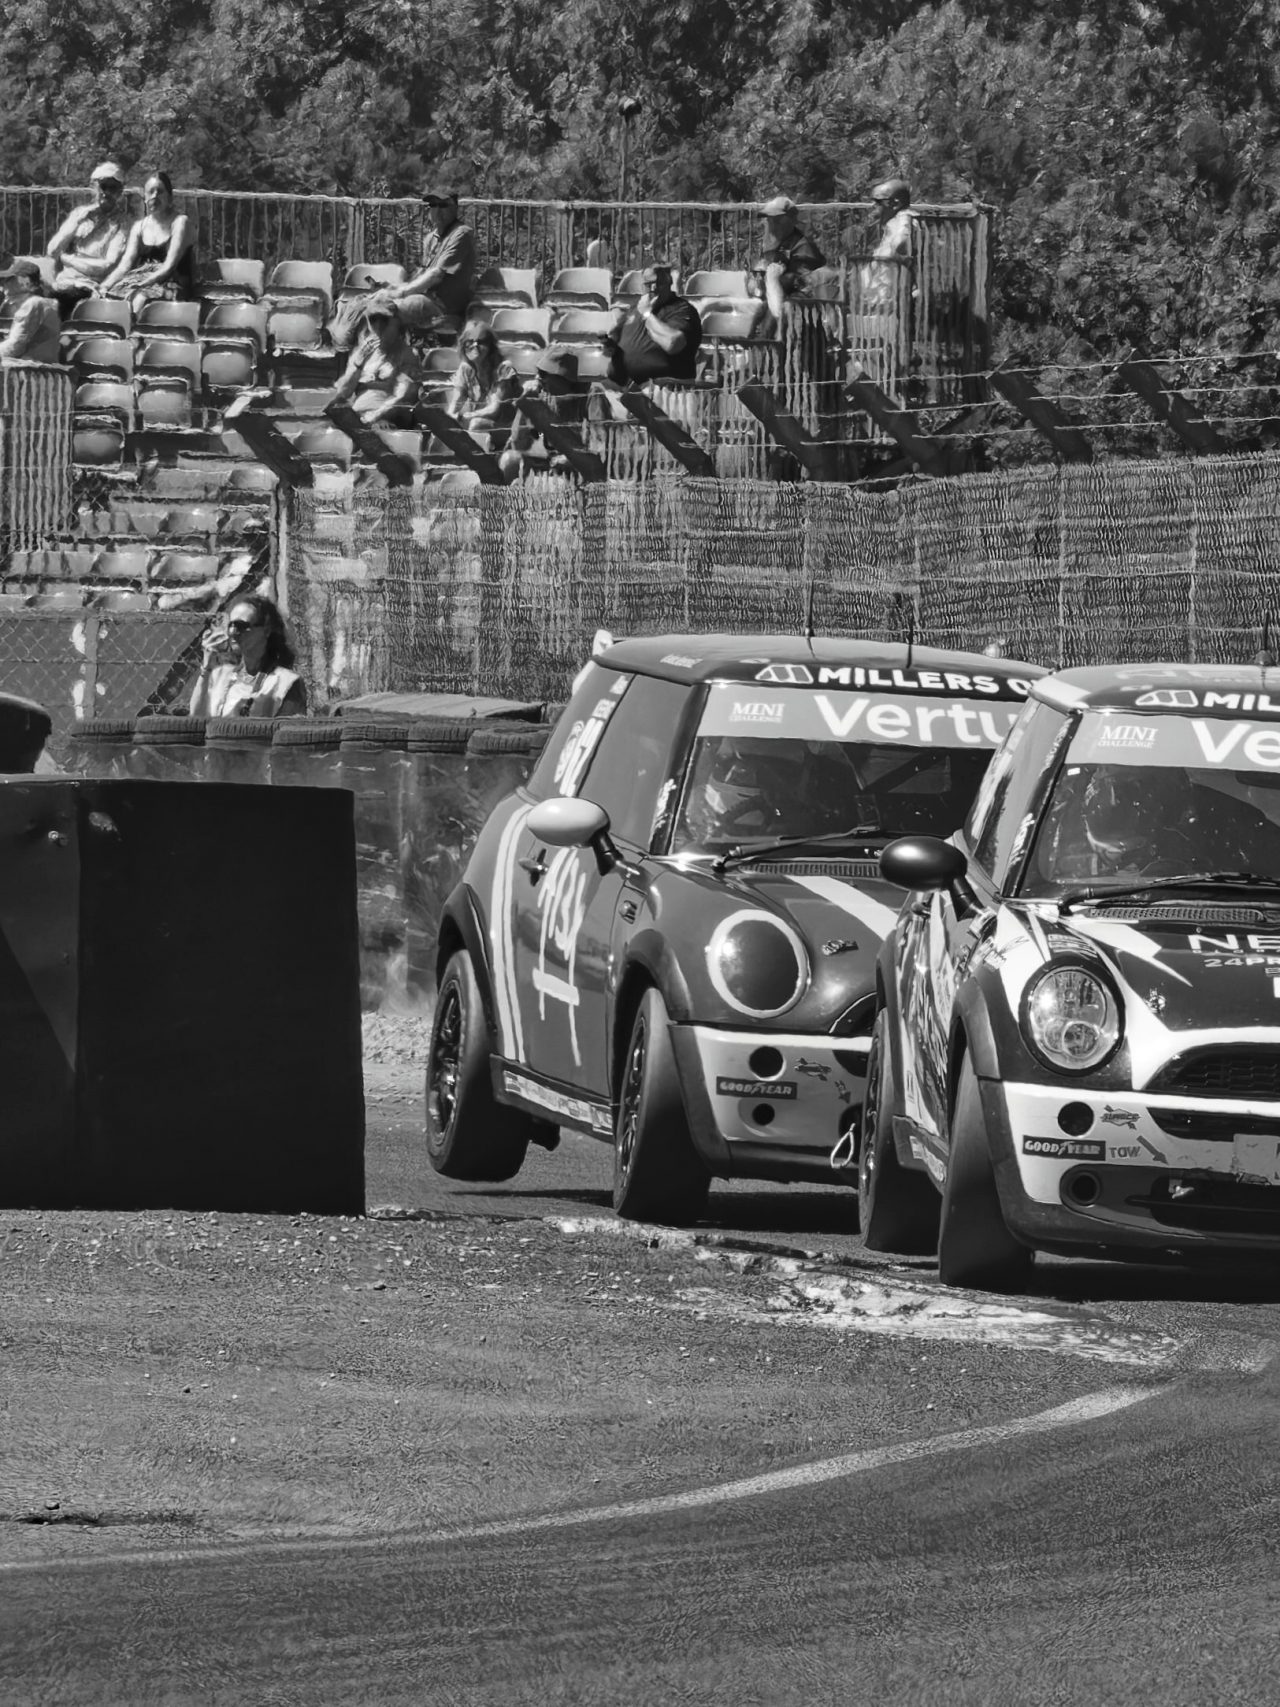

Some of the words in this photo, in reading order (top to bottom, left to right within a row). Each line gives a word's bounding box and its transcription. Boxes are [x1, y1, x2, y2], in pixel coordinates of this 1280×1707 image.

[818, 667, 1000, 694] MILLERS
[732, 702, 786, 717] MINI
[813, 695, 1018, 745] Vertu
[1100, 725, 1158, 741] MINI
[1109, 1146, 1142, 1158] TOW
